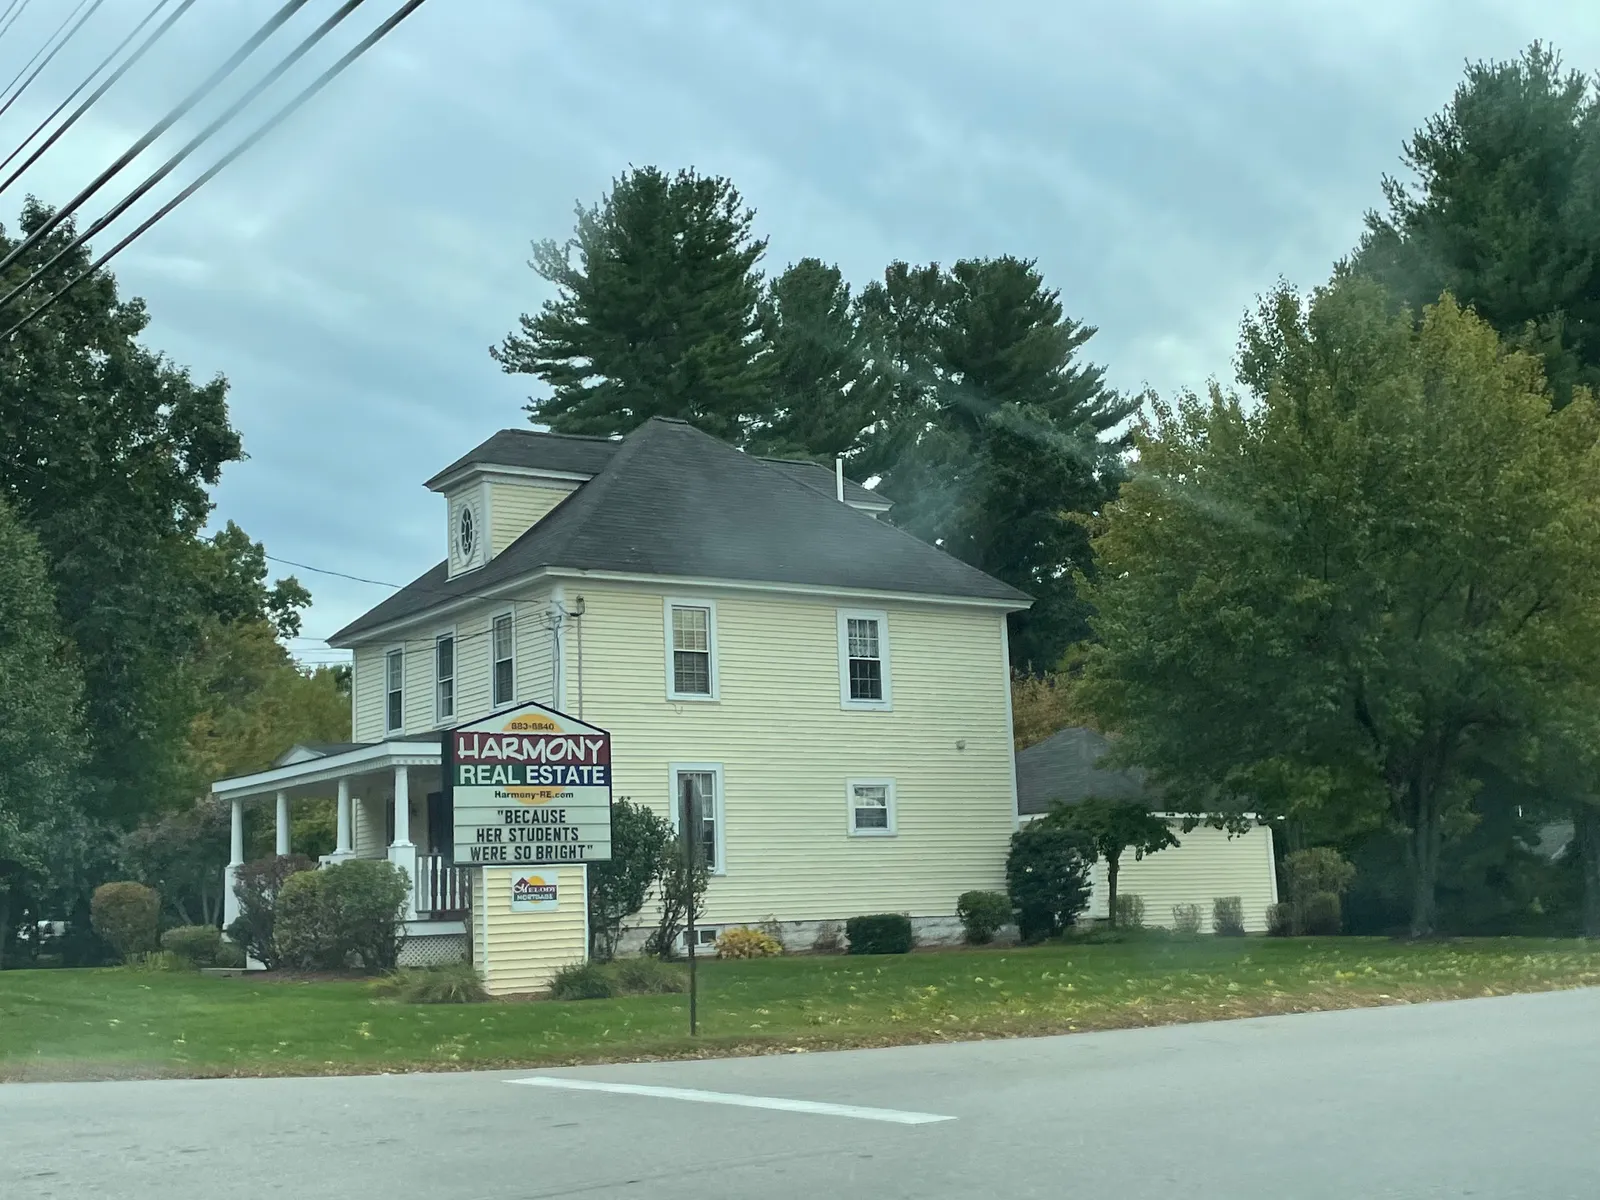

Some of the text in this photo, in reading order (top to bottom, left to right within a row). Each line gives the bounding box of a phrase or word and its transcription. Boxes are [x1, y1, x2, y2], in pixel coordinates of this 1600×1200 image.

[458, 734, 604, 764] HARMONY
[459, 764, 605, 785] REAL ESTATE
[494, 790, 574, 800] Harmony-RE.com
[497, 809, 566, 824] "BECAUSE
[476, 827, 579, 843] HER STUDENTS
[470, 844, 593, 861] WERE SO BRIGHT"
